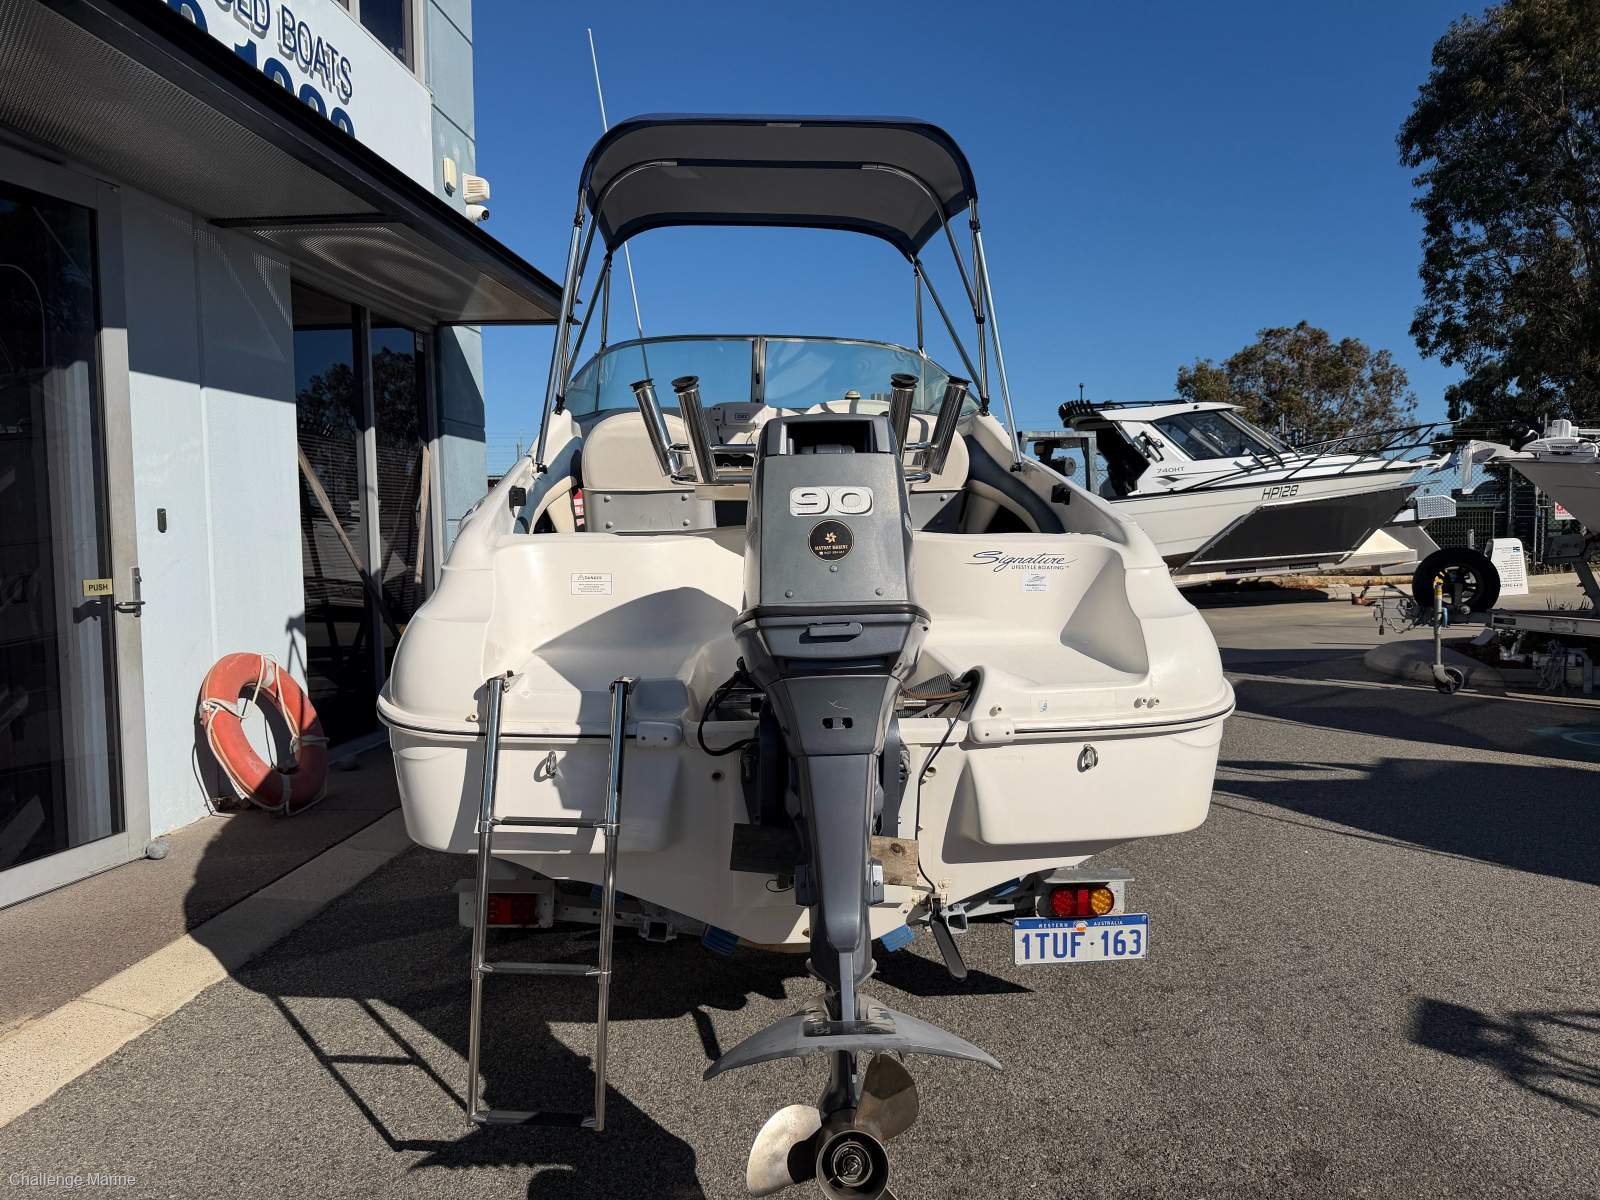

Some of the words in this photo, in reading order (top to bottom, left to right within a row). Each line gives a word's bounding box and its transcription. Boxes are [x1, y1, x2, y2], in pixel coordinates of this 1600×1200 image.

[278, 4, 353, 103] BOATS
[790, 487, 874, 516] 90
[1261, 484, 1299, 500] HP128
[963, 550, 1077, 573] Signature
[88, 583, 108, 591] PUSH
